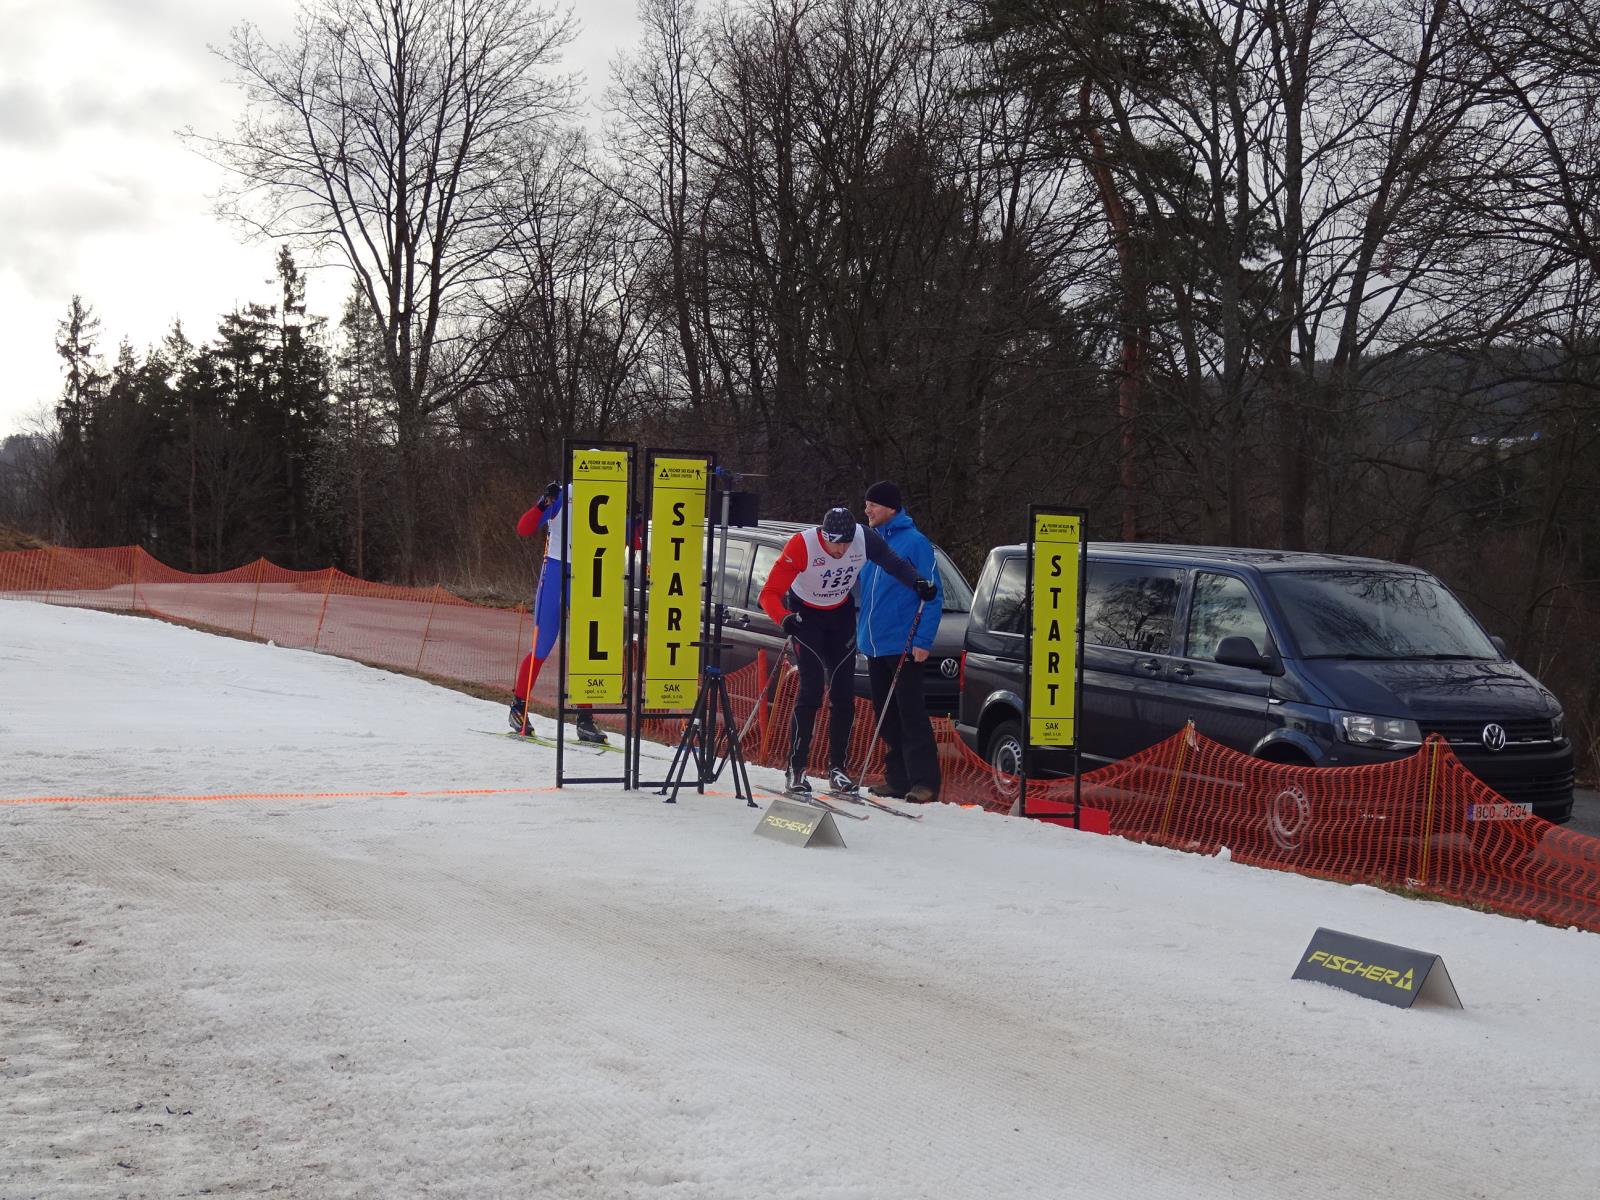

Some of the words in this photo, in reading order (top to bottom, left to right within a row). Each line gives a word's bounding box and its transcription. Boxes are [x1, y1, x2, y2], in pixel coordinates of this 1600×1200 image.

[588, 494, 610, 661] CÍL
[666, 502, 686, 666] START
[822, 575, 852, 589] 152
[1047, 555, 1062, 706] START
[587, 679, 604, 687] SAK
[664, 684, 680, 692] SAK
[1045, 722, 1059, 730] SAK
[763, 815, 805, 832] FISCHER
[1307, 950, 1400, 985] FISCHER
